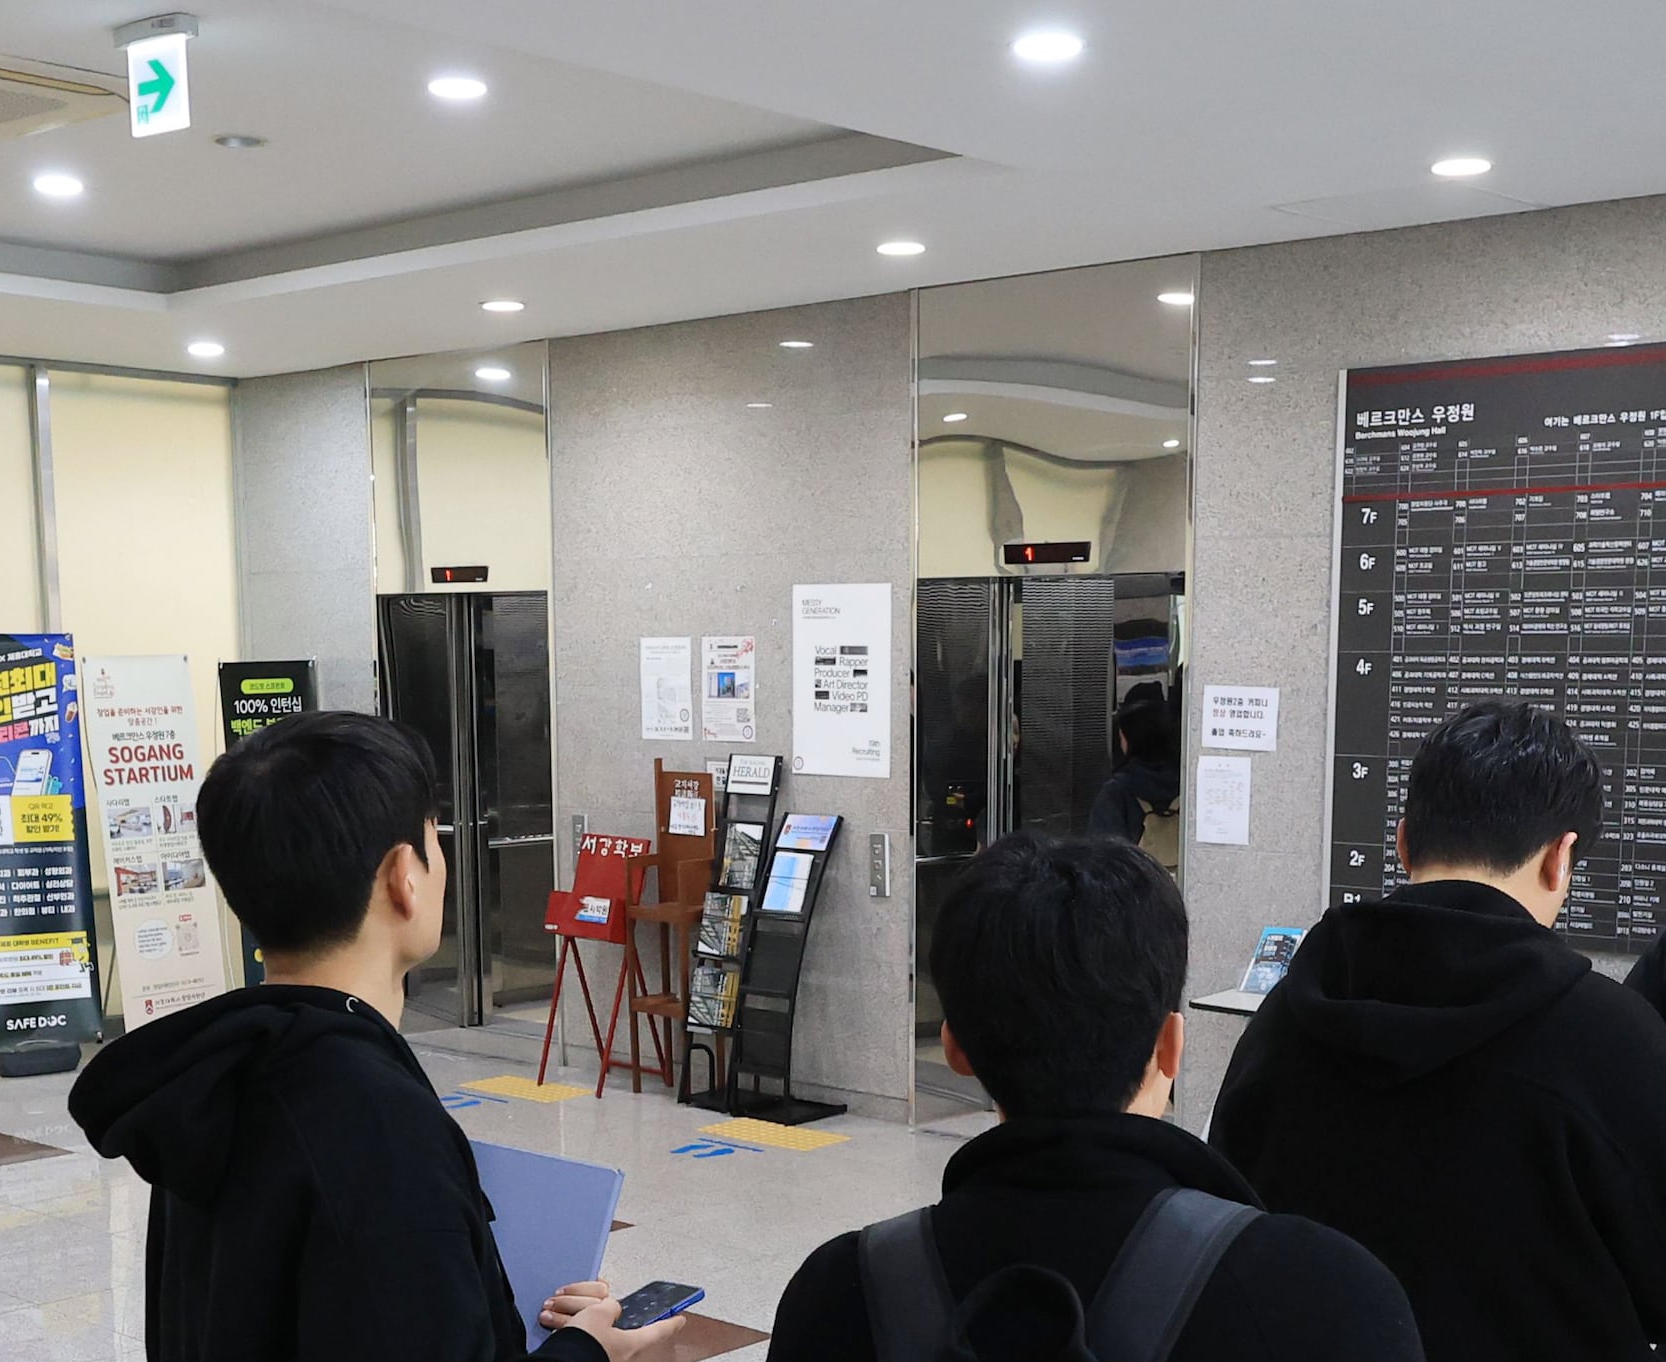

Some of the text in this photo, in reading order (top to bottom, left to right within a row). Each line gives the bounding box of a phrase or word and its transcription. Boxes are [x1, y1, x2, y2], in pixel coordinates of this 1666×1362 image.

[1356, 403, 1475, 428] 베르크만스 우정원
[1544, 416, 1569, 428] 여기는
[1573, 413, 1616, 426] 베르크만스
[1619, 410, 1646, 423] 우정원
[1431, 426, 1446, 435] Hall
[1361, 508, 1378, 524] 7F
[1025, 547, 1033, 561] 1
[1360, 553, 1376, 570] 6F
[445, 570, 451, 581] 1
[802, 607, 840, 615] GENERATION
[1358, 599, 1374, 615] 5F
[815, 646, 837, 655] Vocal
[839, 657, 868, 667] Rapper
[1356, 658, 1373, 675] 4F
[814, 669, 850, 677] Producer
[823, 680, 868, 689] Art Director
[832, 691, 868, 701] Video PD
[233, 696, 302, 714] 100% 인턴십
[814, 703, 850, 714] Manager
[108, 743, 184, 764] SOGANG
[103, 764, 194, 786] STARTIUM
[733, 766, 770, 778] HERALD
[1353, 762, 1369, 779] 3F
[21, 813, 63, 823] 최대 49%
[26, 825, 41, 834] 할인
[582, 836, 643, 858] 서강학보
[1350, 851, 1366, 867] 2F
[11, 881, 40, 890] 다이어트
[61, 905, 75, 913] 내과
